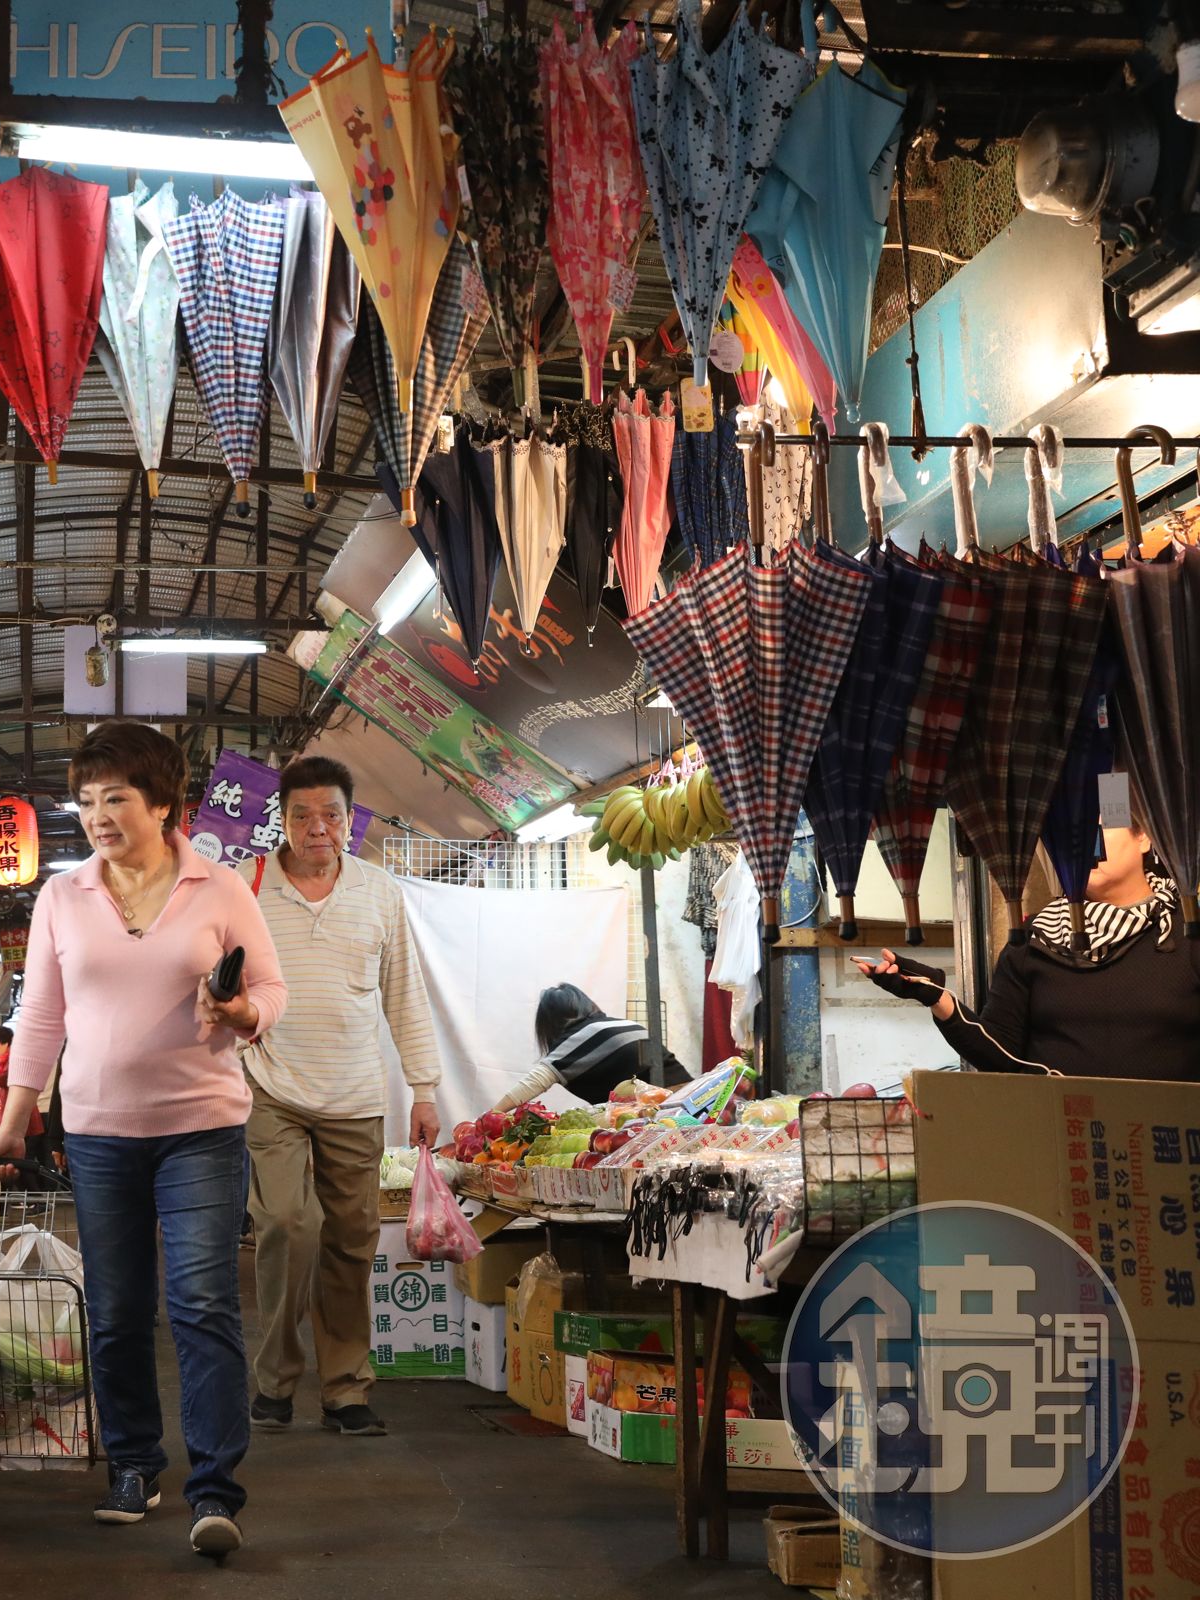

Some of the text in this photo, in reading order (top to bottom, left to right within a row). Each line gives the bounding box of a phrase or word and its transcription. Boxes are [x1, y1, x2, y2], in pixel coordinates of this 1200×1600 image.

[1127, 1122, 1158, 1307] Natural Pistachios
[1151, 1124, 1196, 1308] 開心果
[372, 1254, 395, 1363] 品質保證
[398, 1279, 421, 1306] 錦
[1166, 1371, 1186, 1427] U.S.A.
